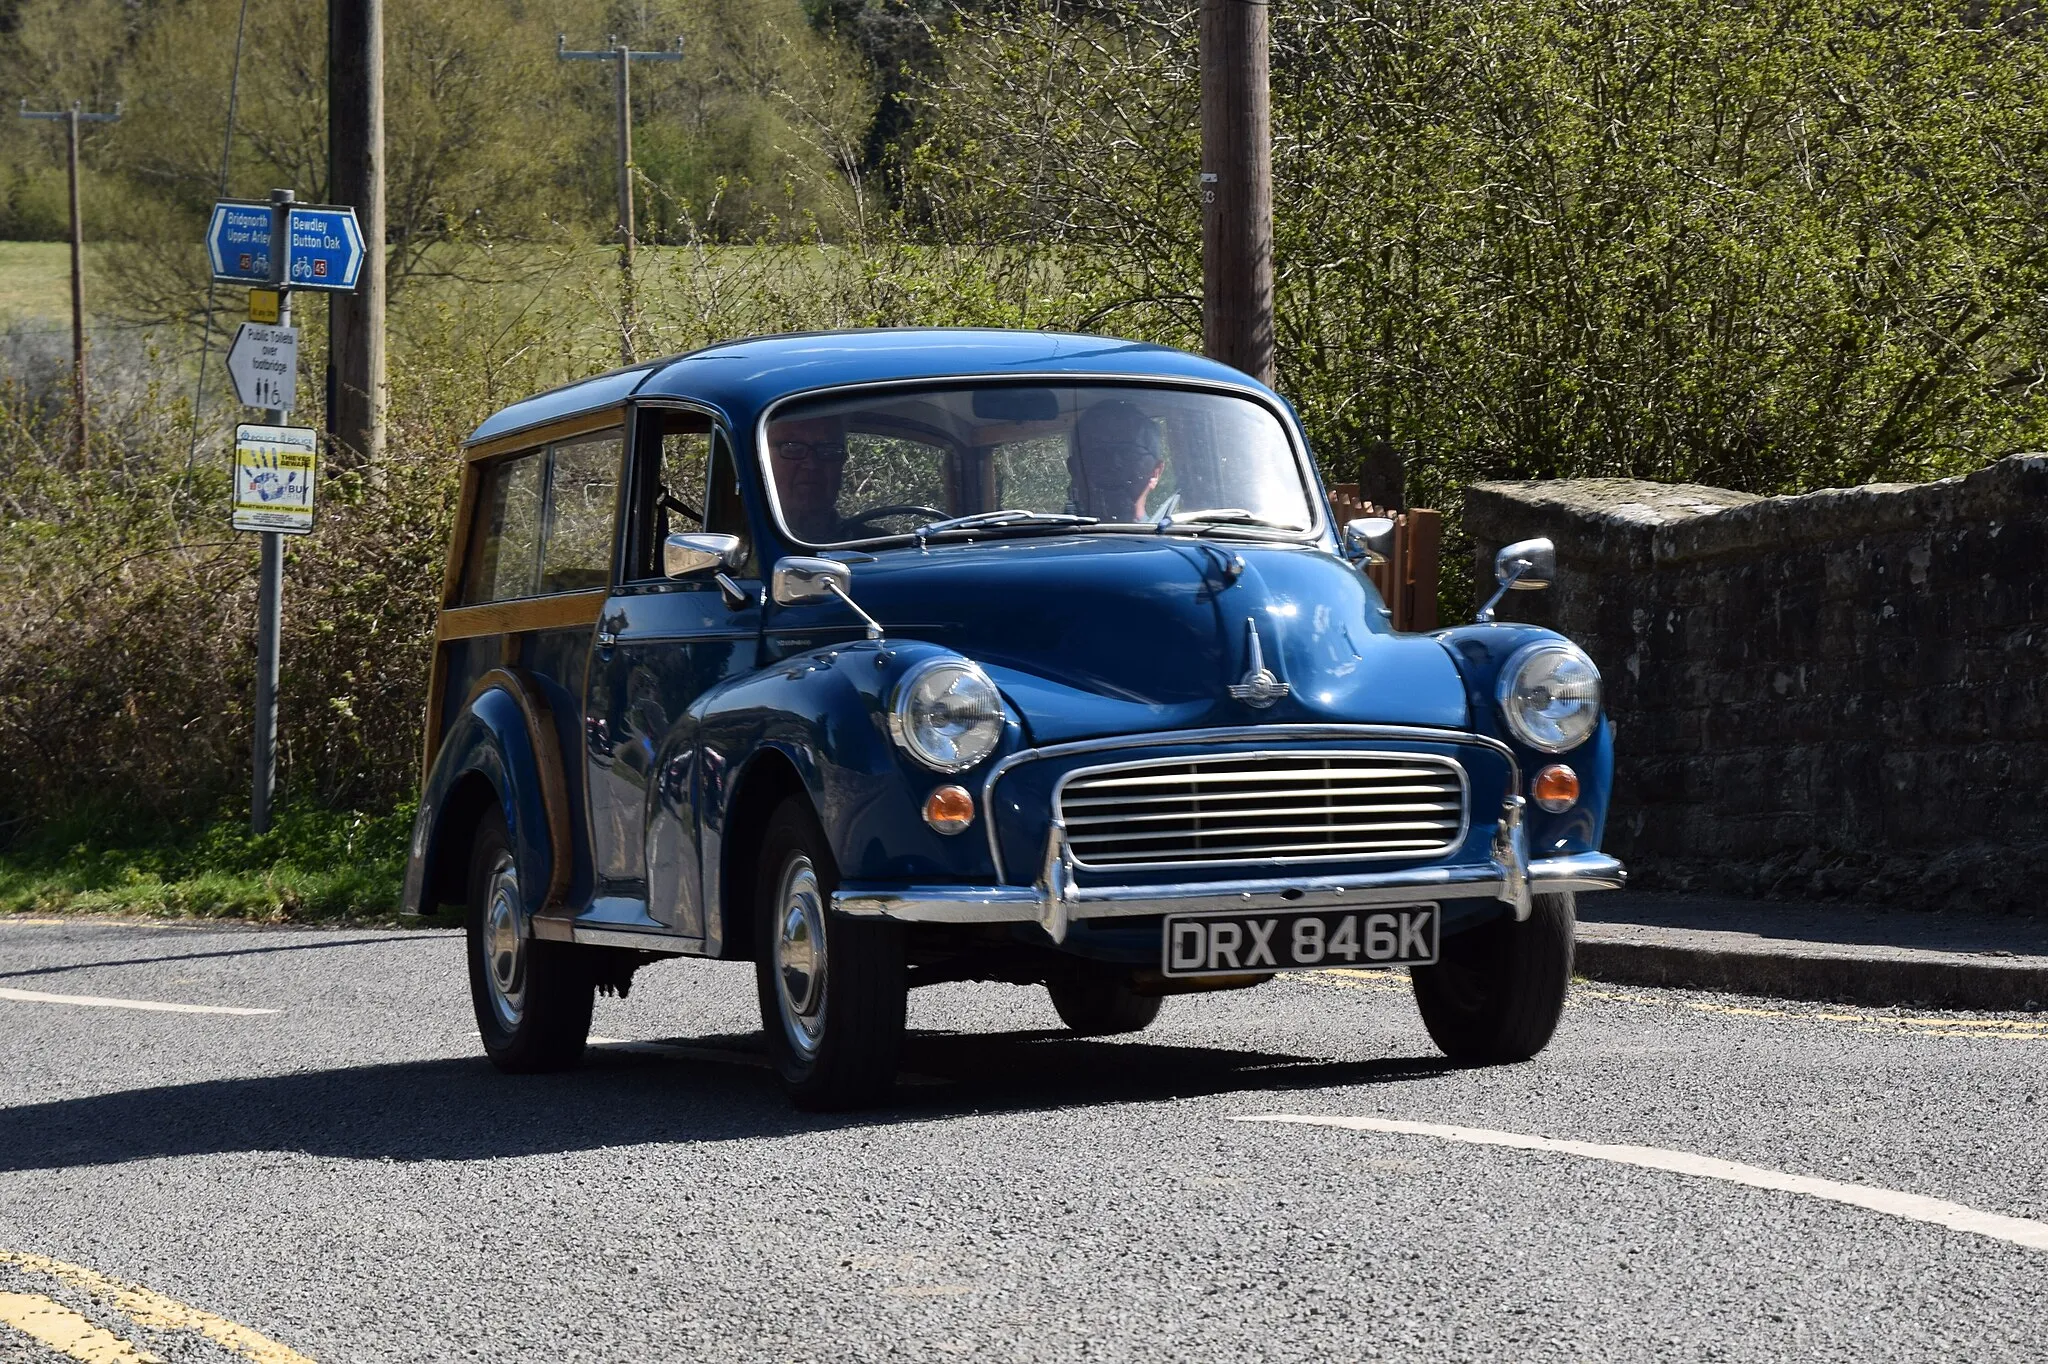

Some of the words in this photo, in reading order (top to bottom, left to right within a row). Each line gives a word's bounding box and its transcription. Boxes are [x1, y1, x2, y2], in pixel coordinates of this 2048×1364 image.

[228, 212, 268, 228] Bridgnorth
[293, 217, 328, 234] Bewdley
[228, 229, 250, 243] Upper
[252, 230, 271, 246] Arley
[293, 234, 321, 248] Button
[324, 236, 341, 249] Oak
[315, 261, 326, 274] 45
[248, 328, 268, 342] Public
[270, 330, 294, 345] Toilets
[262, 346, 278, 356] over
[252, 356, 287, 375] footbridge
[287, 437, 313, 445] POLICE
[281, 454, 311, 462] THIEVES
[281, 460, 311, 468] BEWARE
[288, 485, 310, 493] BUY
[1172, 919, 1279, 969] DRX
[1291, 911, 1432, 964] 846K
